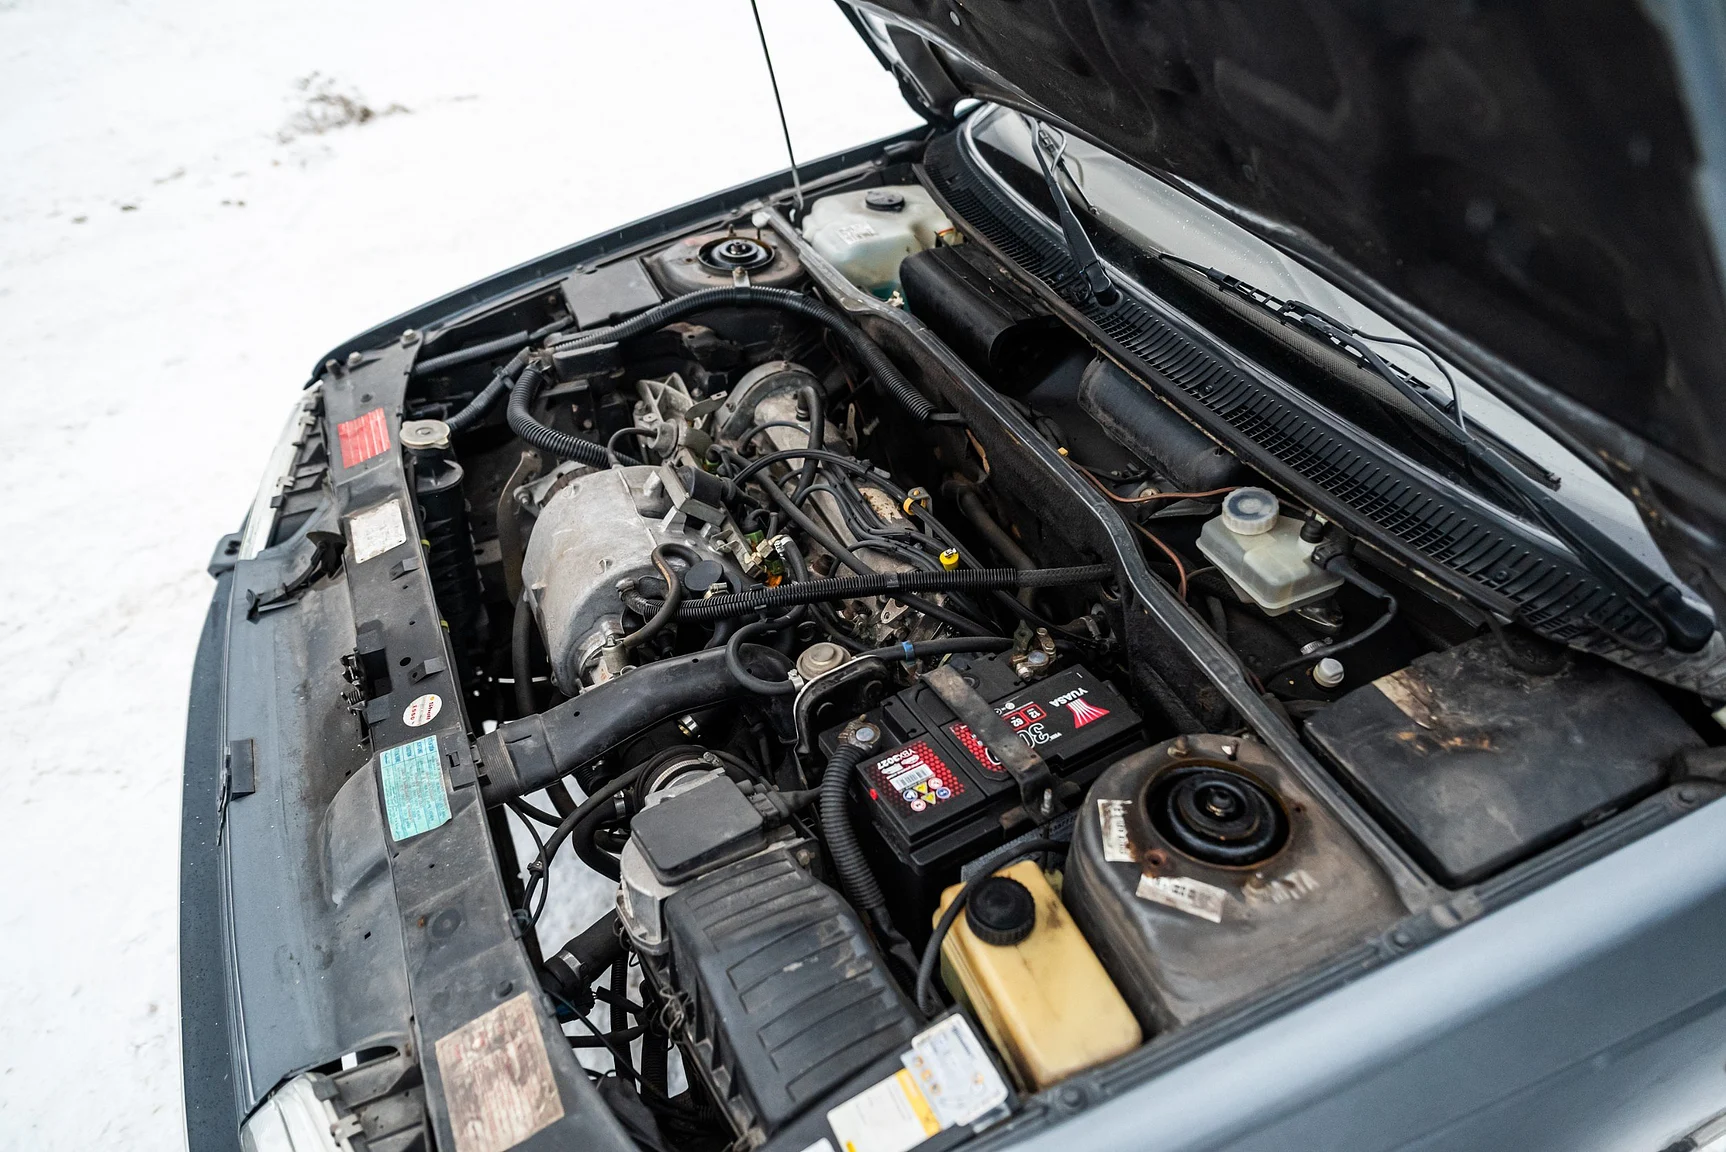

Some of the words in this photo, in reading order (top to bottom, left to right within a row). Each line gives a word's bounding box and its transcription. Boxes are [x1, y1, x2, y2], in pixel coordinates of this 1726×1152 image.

[1049, 687, 1088, 707] YUASA
[1029, 709, 1041, 719] 12
[877, 748, 916, 770] YBX3027
